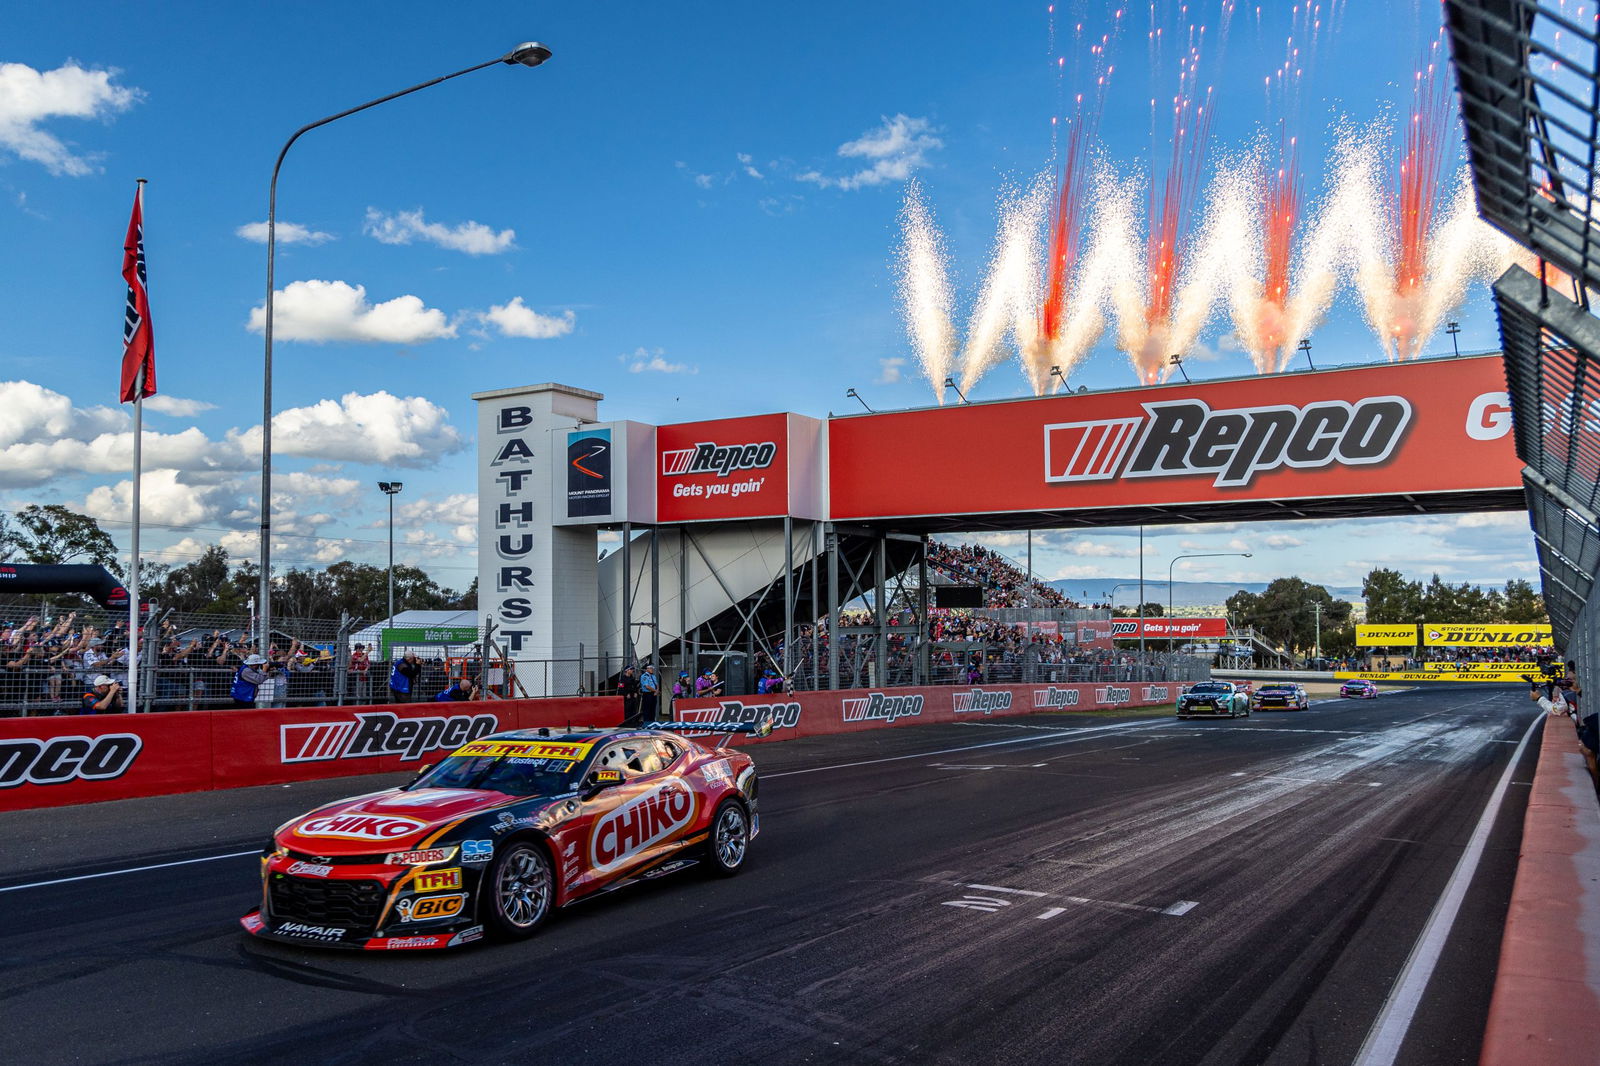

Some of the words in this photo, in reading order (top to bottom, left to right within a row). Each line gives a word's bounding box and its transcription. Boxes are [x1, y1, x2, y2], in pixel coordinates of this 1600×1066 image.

[1121, 395, 1413, 488] Repco
[688, 441, 777, 477] Repco
[673, 483, 703, 498] Gets
[705, 484, 729, 499] you
[731, 477, 765, 497] goin'
[491, 406, 535, 656] BATHURST
[424, 629, 453, 641] Merlin
[1143, 623, 1163, 632] Gets
[1443, 632, 1553, 643] DUNLOP
[968, 688, 1013, 715] Repco
[1047, 685, 1079, 709] Repco
[1105, 685, 1131, 705] Repco
[1149, 684, 1168, 703] Repco
[864, 692, 925, 723] Repco
[340, 711, 499, 761] Repco
[539, 745, 577, 756] TFH
[600, 771, 616, 779] TFH
[304, 816, 420, 837] CHIKO
[490, 821, 511, 832] TREE
[595, 790, 691, 866] CHIKO
[403, 849, 444, 862] PEDDERS
[462, 840, 493, 854] SS
[463, 852, 492, 862] SIGNS
[419, 872, 456, 888] TFH
[279, 921, 347, 937] NAVAIR
